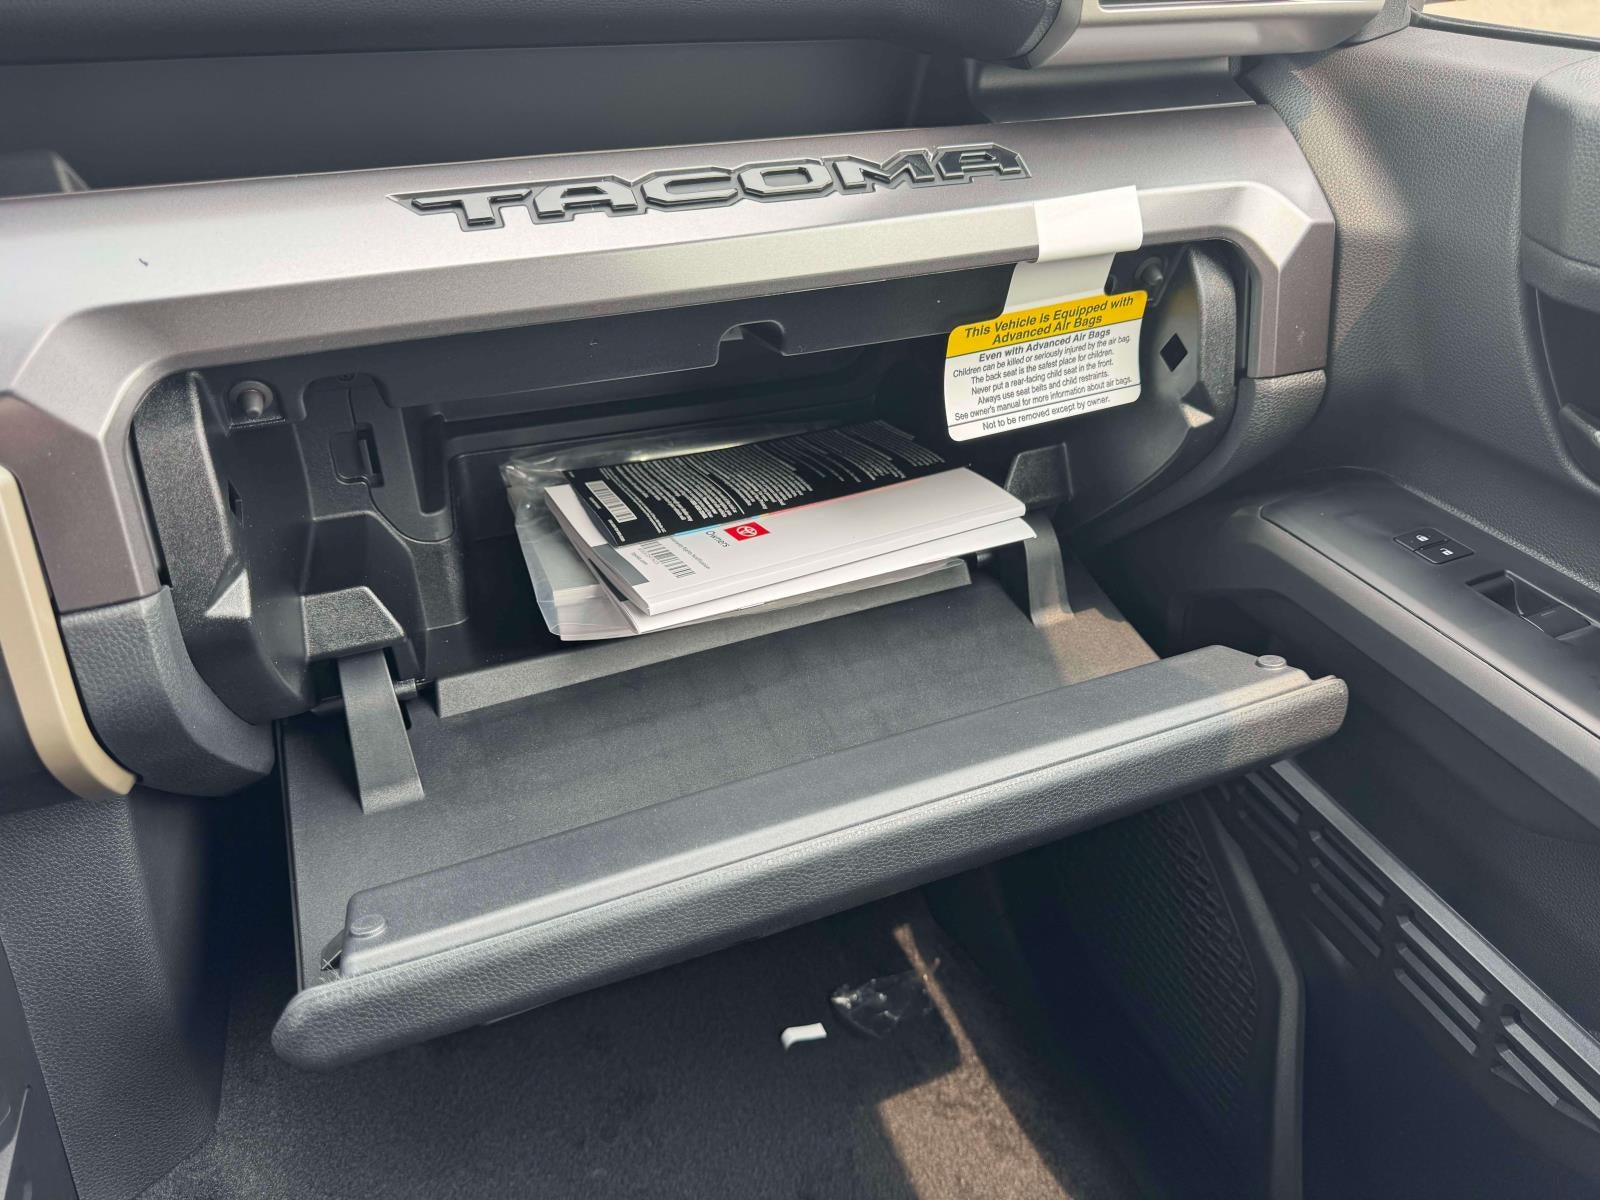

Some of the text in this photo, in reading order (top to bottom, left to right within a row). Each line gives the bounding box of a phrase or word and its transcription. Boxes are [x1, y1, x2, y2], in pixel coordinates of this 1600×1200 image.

[405, 146, 1028, 229] TACOMA
[965, 326, 990, 338] This
[995, 316, 1036, 332] Vehicle
[1053, 300, 1108, 320] Equipped
[1110, 296, 1134, 309] with
[992, 315, 1102, 345] Advanced Air Bags
[953, 365, 981, 378] Children
[983, 363, 995, 372] can
[997, 360, 1005, 368] be
[1007, 355, 1024, 366] killed
[1025, 354, 1034, 363] or
[1034, 348, 1063, 361] seriously
[1064, 343, 1086, 356] injured
[1087, 342, 1095, 350] by
[1097, 339, 1107, 347] the
[1108, 337, 1117, 345] air
[979, 328, 1111, 362] Even with Advanced Air Bags
[971, 376, 984, 384] The
[985, 371, 1002, 382] back
[1002, 369, 1017, 378] seat
[1018, 366, 1025, 375] is
[1025, 362, 1036, 371] the
[1038, 360, 1058, 371] safest
[1058, 357, 1077, 368] place
[1077, 354, 1087, 362] for
[971, 385, 991, 395] Never
[992, 382, 1004, 393] put
[1010, 373, 1046, 387] rear-facing
[1046, 369, 1062, 379] child
[1063, 366, 1078, 376] seat
[1078, 364, 1085, 372] in
[1086, 362, 1097, 370] the
[954, 412, 969, 421] See
[969, 406, 995, 418] owner's
[996, 400, 1021, 412] manual
[1022, 397, 1031, 406] for
[1032, 394, 1049, 403] more
[1050, 386, 1086, 400] information
[1087, 381, 1105, 391] about
[1106, 379, 1114, 387] air
[978, 395, 1001, 405] Always
[1002, 391, 1015, 400] use
[1016, 388, 1030, 397] seat
[1031, 384, 1048, 395] belts
[1048, 380, 1061, 389] and
[1062, 377, 1077, 386] child
[982, 396, 1111, 430] Not to be removed except by owner.
